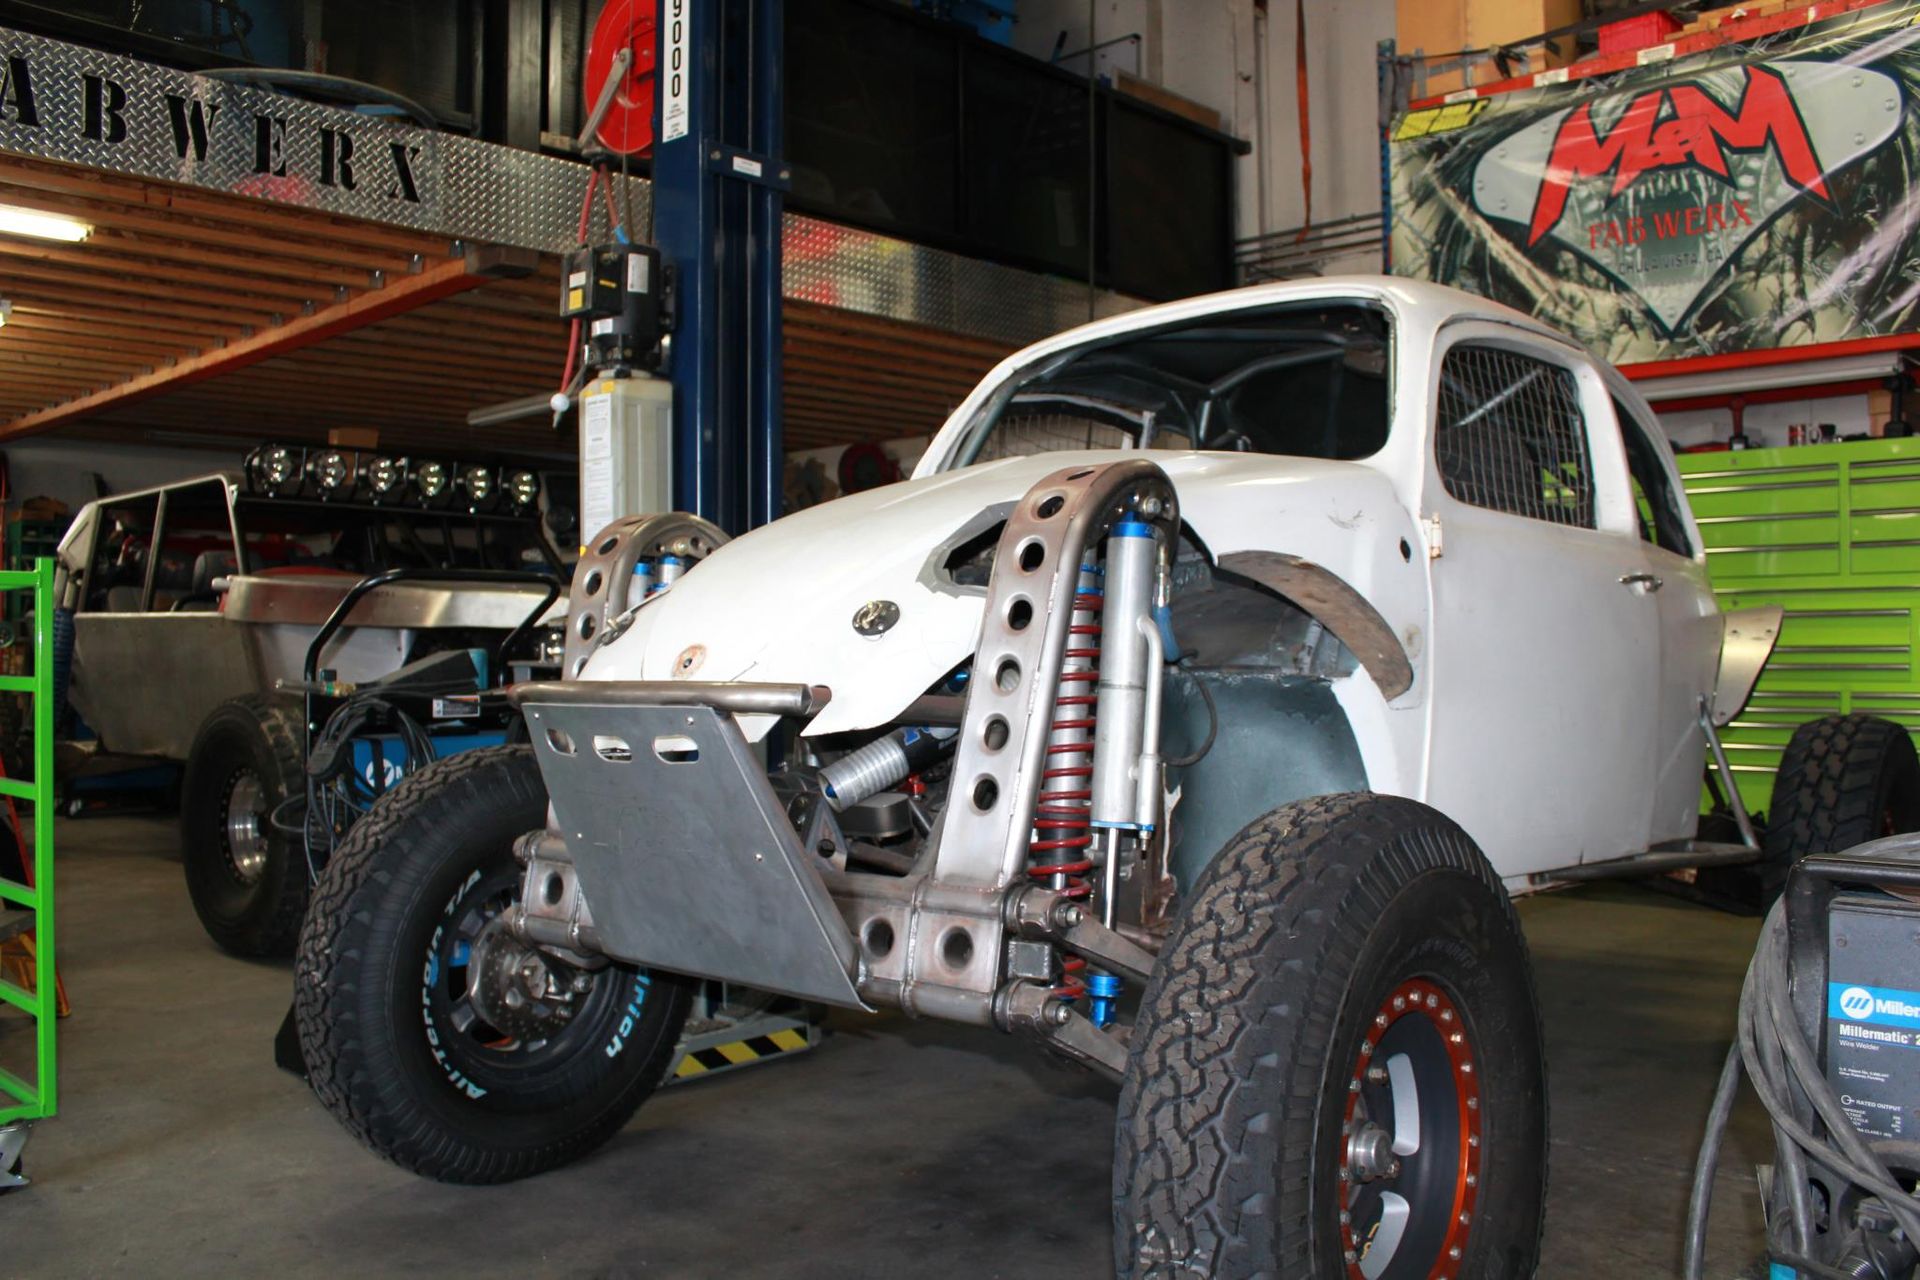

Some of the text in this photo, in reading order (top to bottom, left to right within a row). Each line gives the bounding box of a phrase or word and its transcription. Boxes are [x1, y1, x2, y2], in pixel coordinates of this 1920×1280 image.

[1588, 197, 1753, 254] FAB WERX
[1855, 1099, 1902, 1113] RATED OUTPUT
